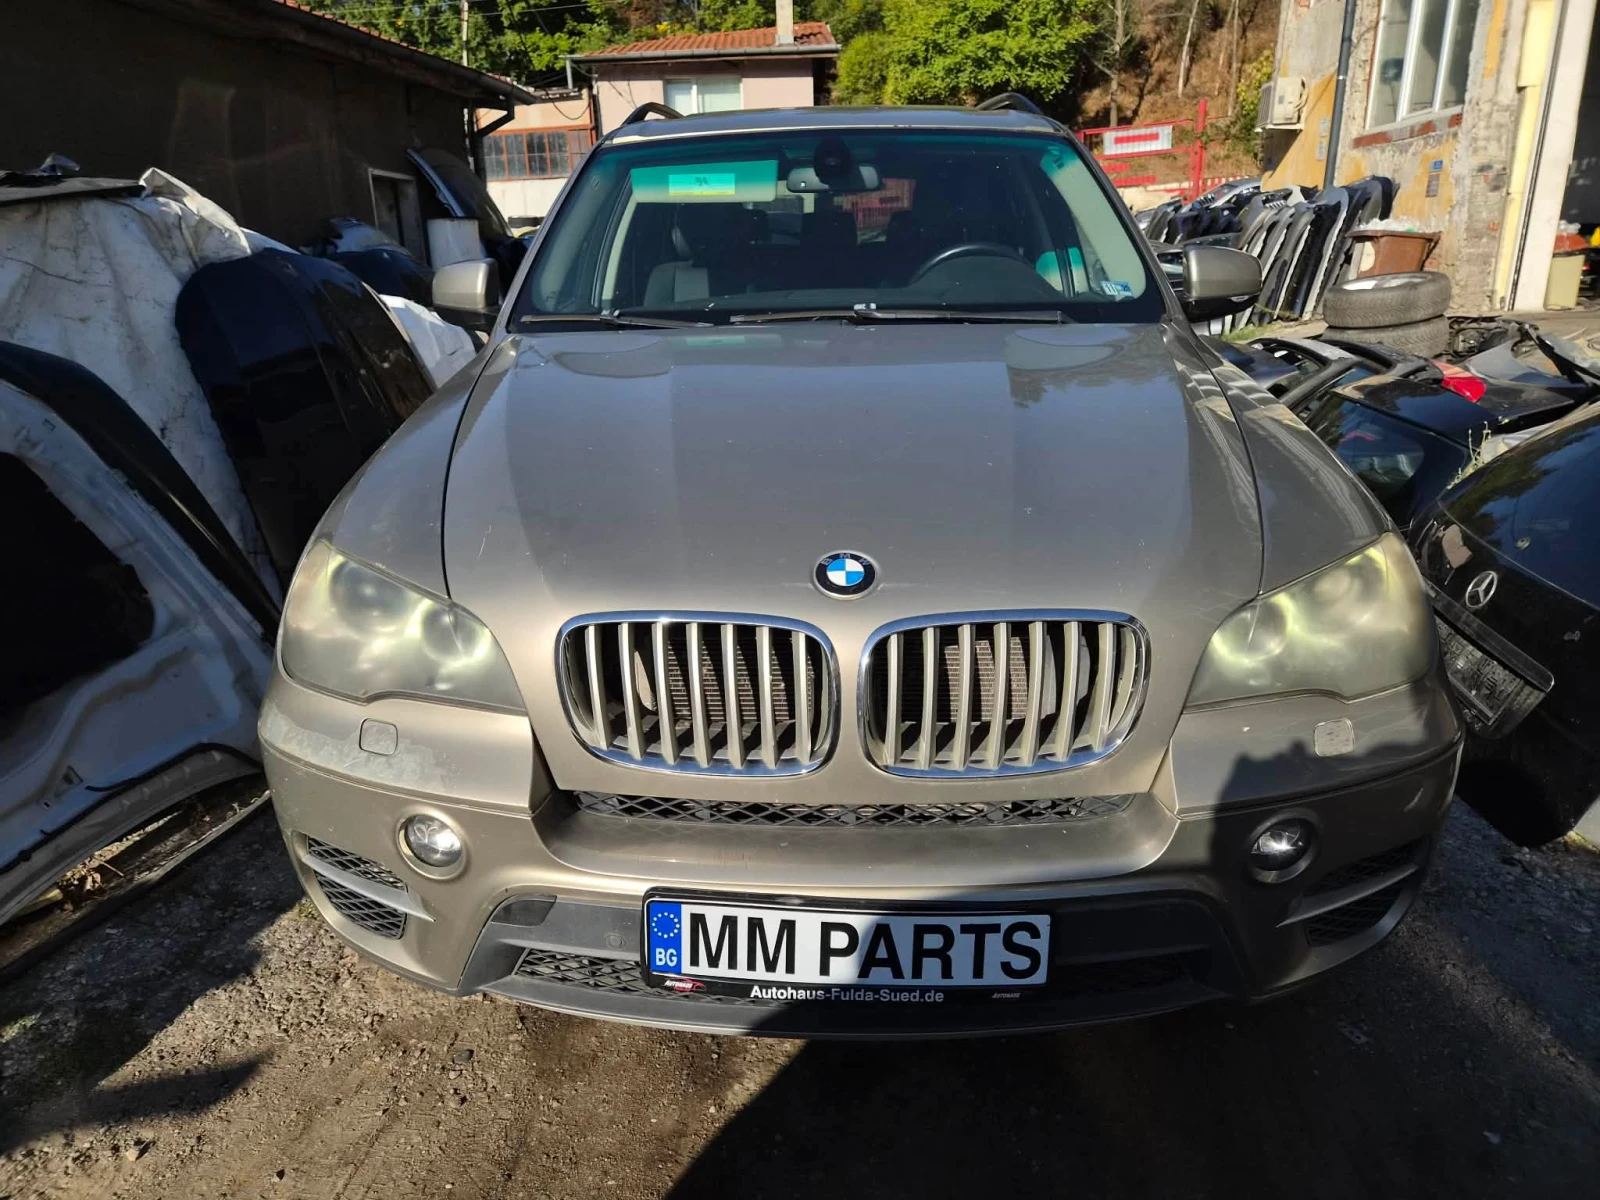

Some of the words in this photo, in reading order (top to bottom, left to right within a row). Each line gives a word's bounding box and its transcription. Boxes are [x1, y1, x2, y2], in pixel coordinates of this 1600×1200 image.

[820, 553, 871, 566] BMW
[689, 912, 796, 975] MM
[819, 921, 1042, 980] PARTS
[655, 947, 678, 967] BG
[749, 985, 945, 1003] Autohaus-Fulda-Sued.de
